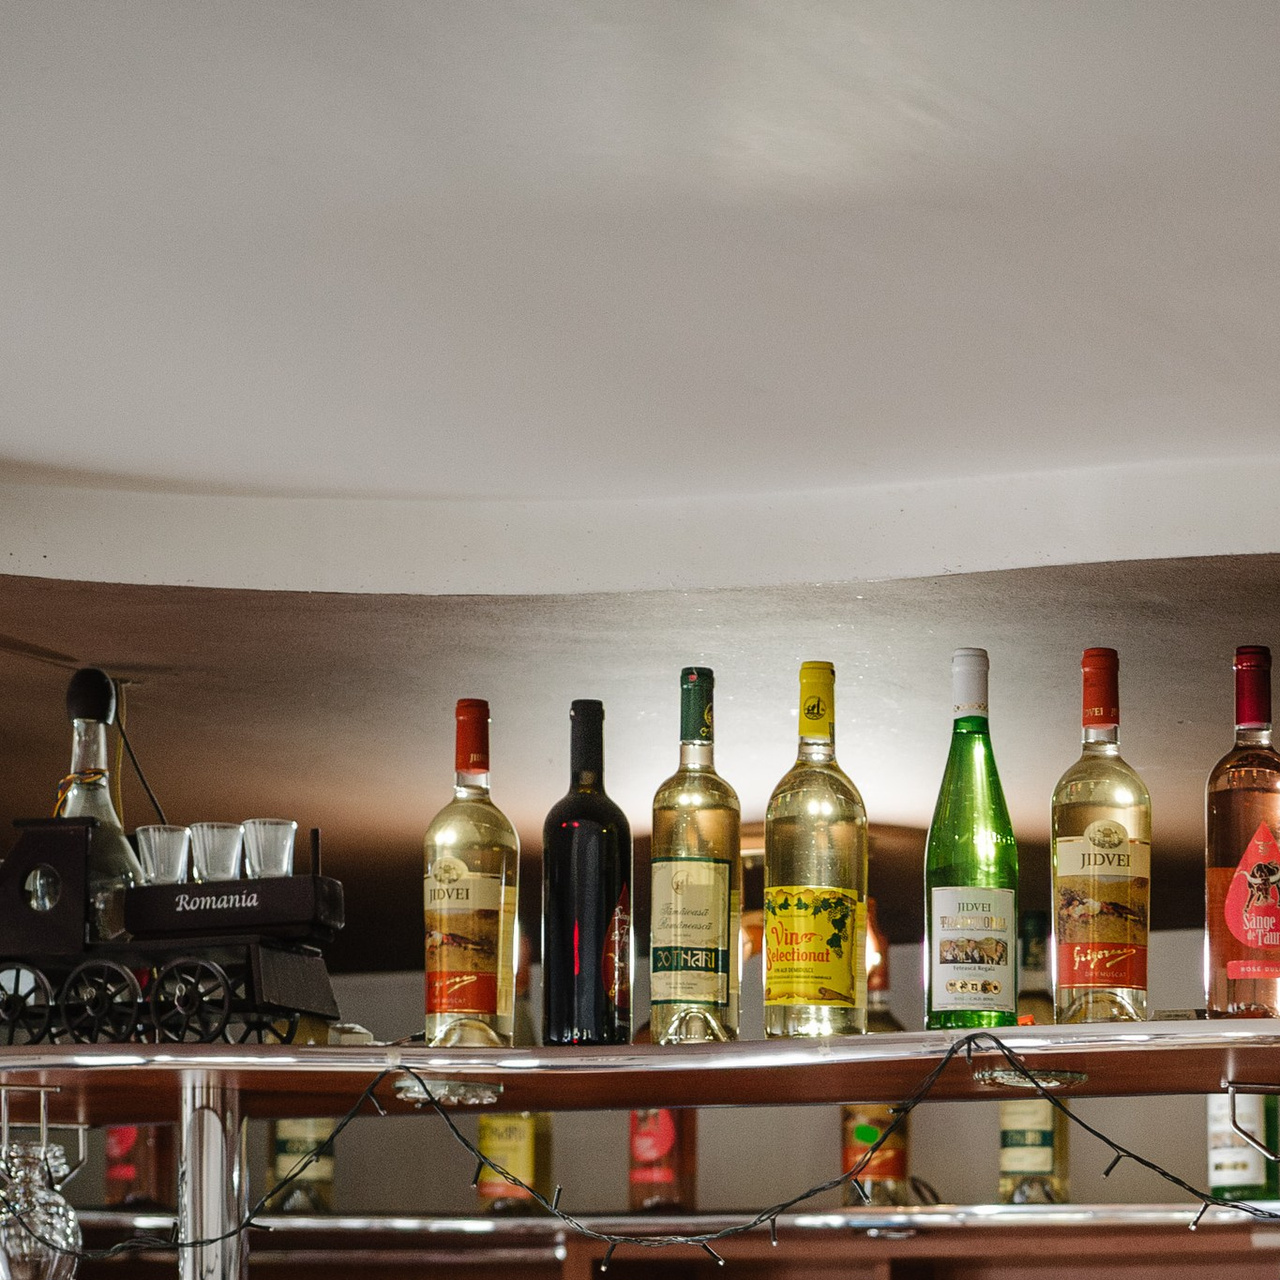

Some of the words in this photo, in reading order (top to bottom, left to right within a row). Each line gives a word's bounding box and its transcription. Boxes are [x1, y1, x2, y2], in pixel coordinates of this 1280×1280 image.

[1081, 853, 1131, 869] JIDVEI
[175, 890, 259, 912] Romania
[429, 888, 470, 903] JIDVEI
[957, 902, 991, 913] JIDVEI
[1243, 913, 1276, 931] Sânge
